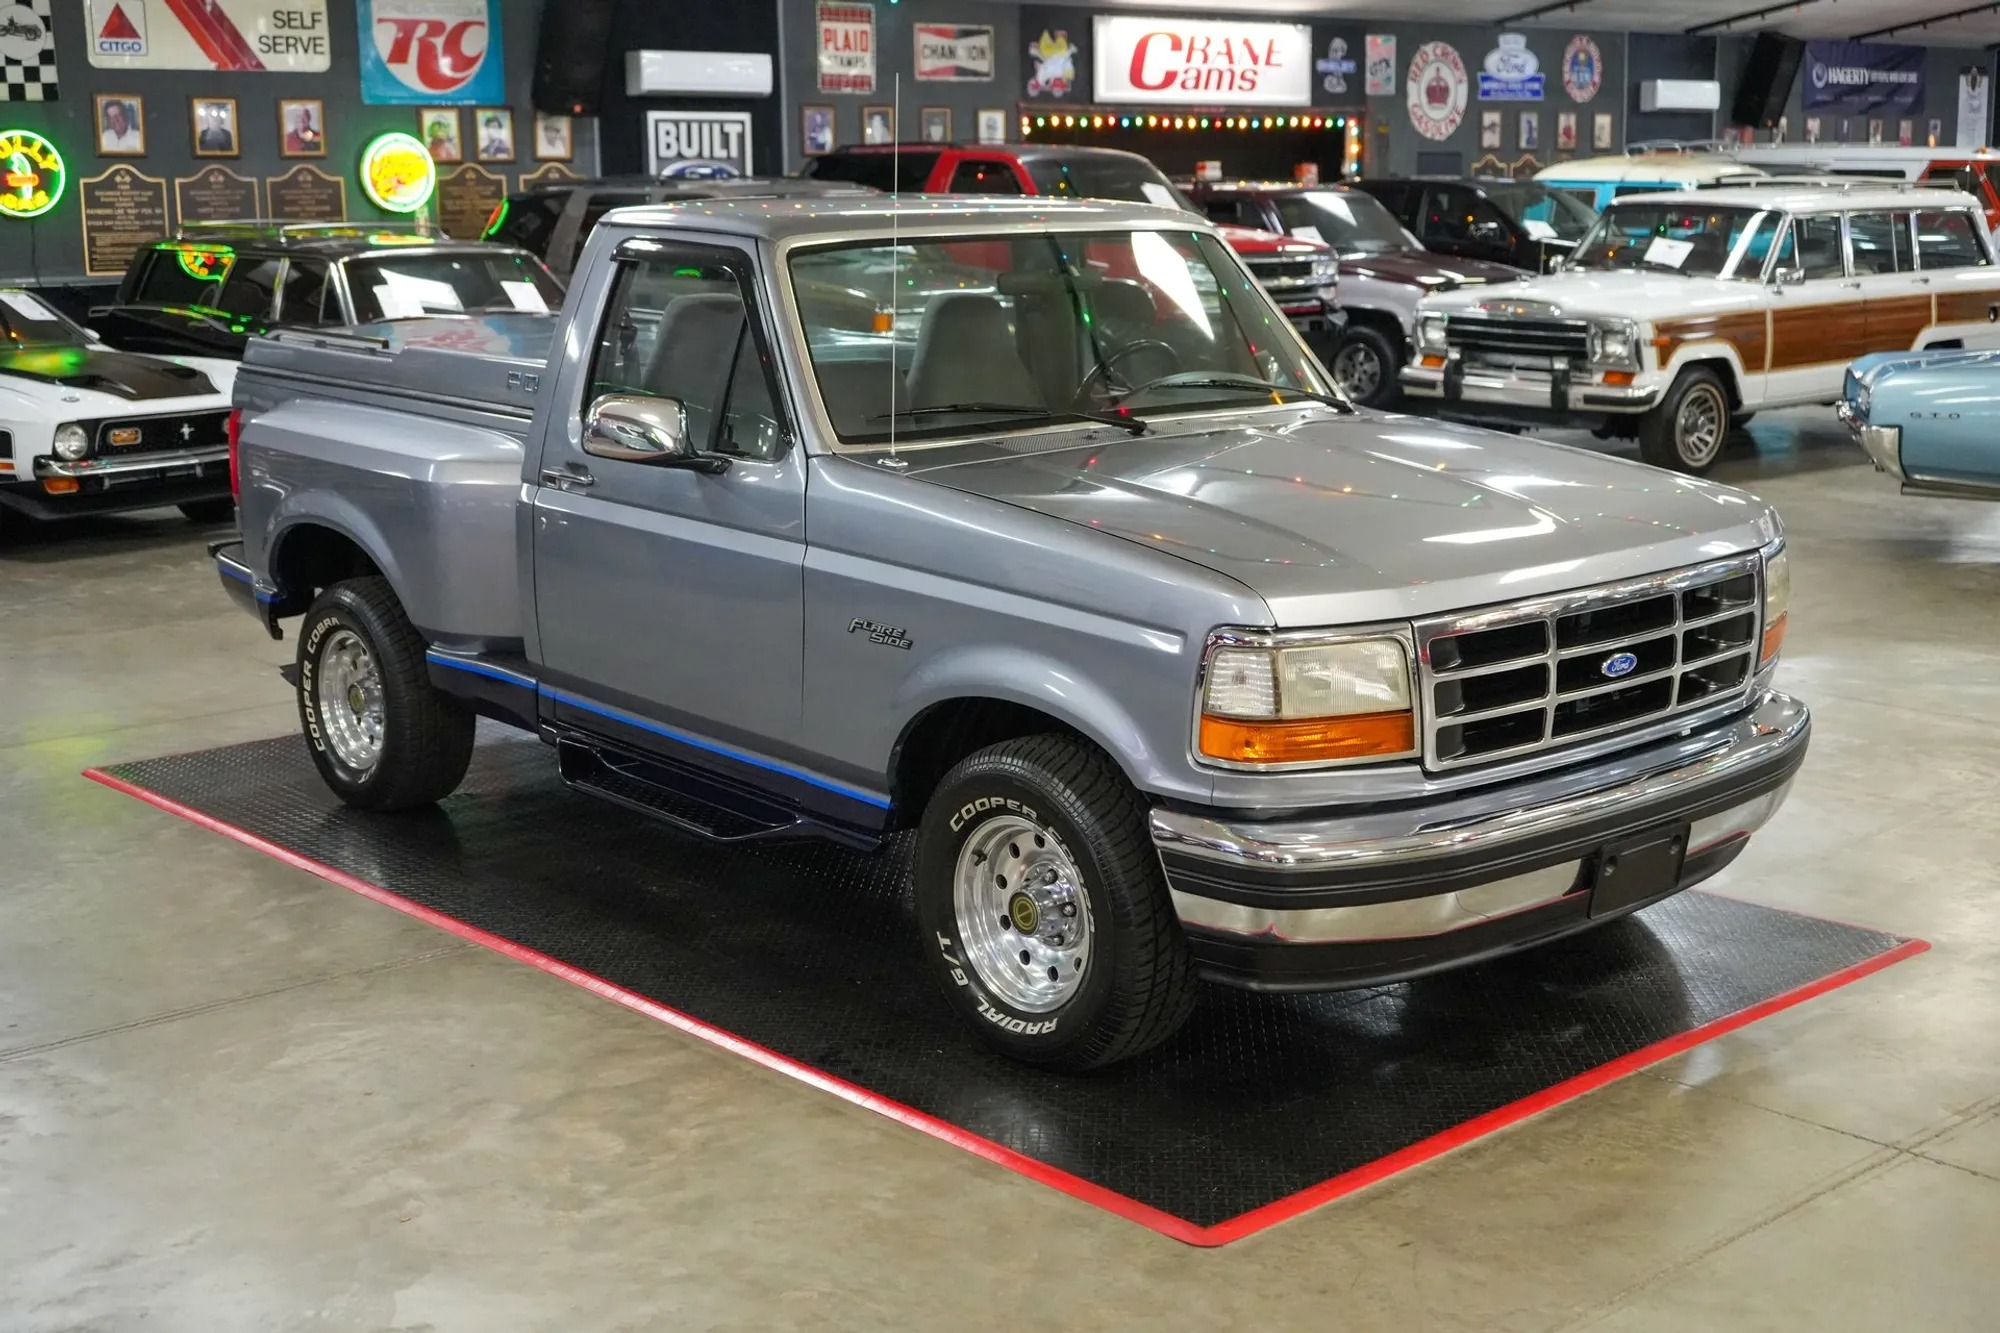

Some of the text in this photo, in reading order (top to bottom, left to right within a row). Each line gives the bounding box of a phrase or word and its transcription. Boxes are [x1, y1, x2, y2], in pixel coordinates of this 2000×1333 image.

[272, 10, 323, 29] SELF
[100, 40, 142, 53] CITGO
[258, 35, 325, 55] SERVE
[823, 28, 869, 52] PLAID
[377, 17, 486, 91] RC
[1129, 32, 1283, 91] CRANE
[1496, 53, 1527, 73] Ford
[1410, 50, 1430, 83] RED
[1827, 66, 1870, 85] HAGERTY
[657, 121, 744, 159] BUILT
[848, 617, 905, 638] FLARE
[869, 632, 912, 650] SIDE
[1611, 657, 1631, 672] Ford
[303, 616, 341, 752] COOPER COBRA
[949, 796, 1038, 833] COOPER
[936, 931, 1058, 1035] RADIAL G/T
